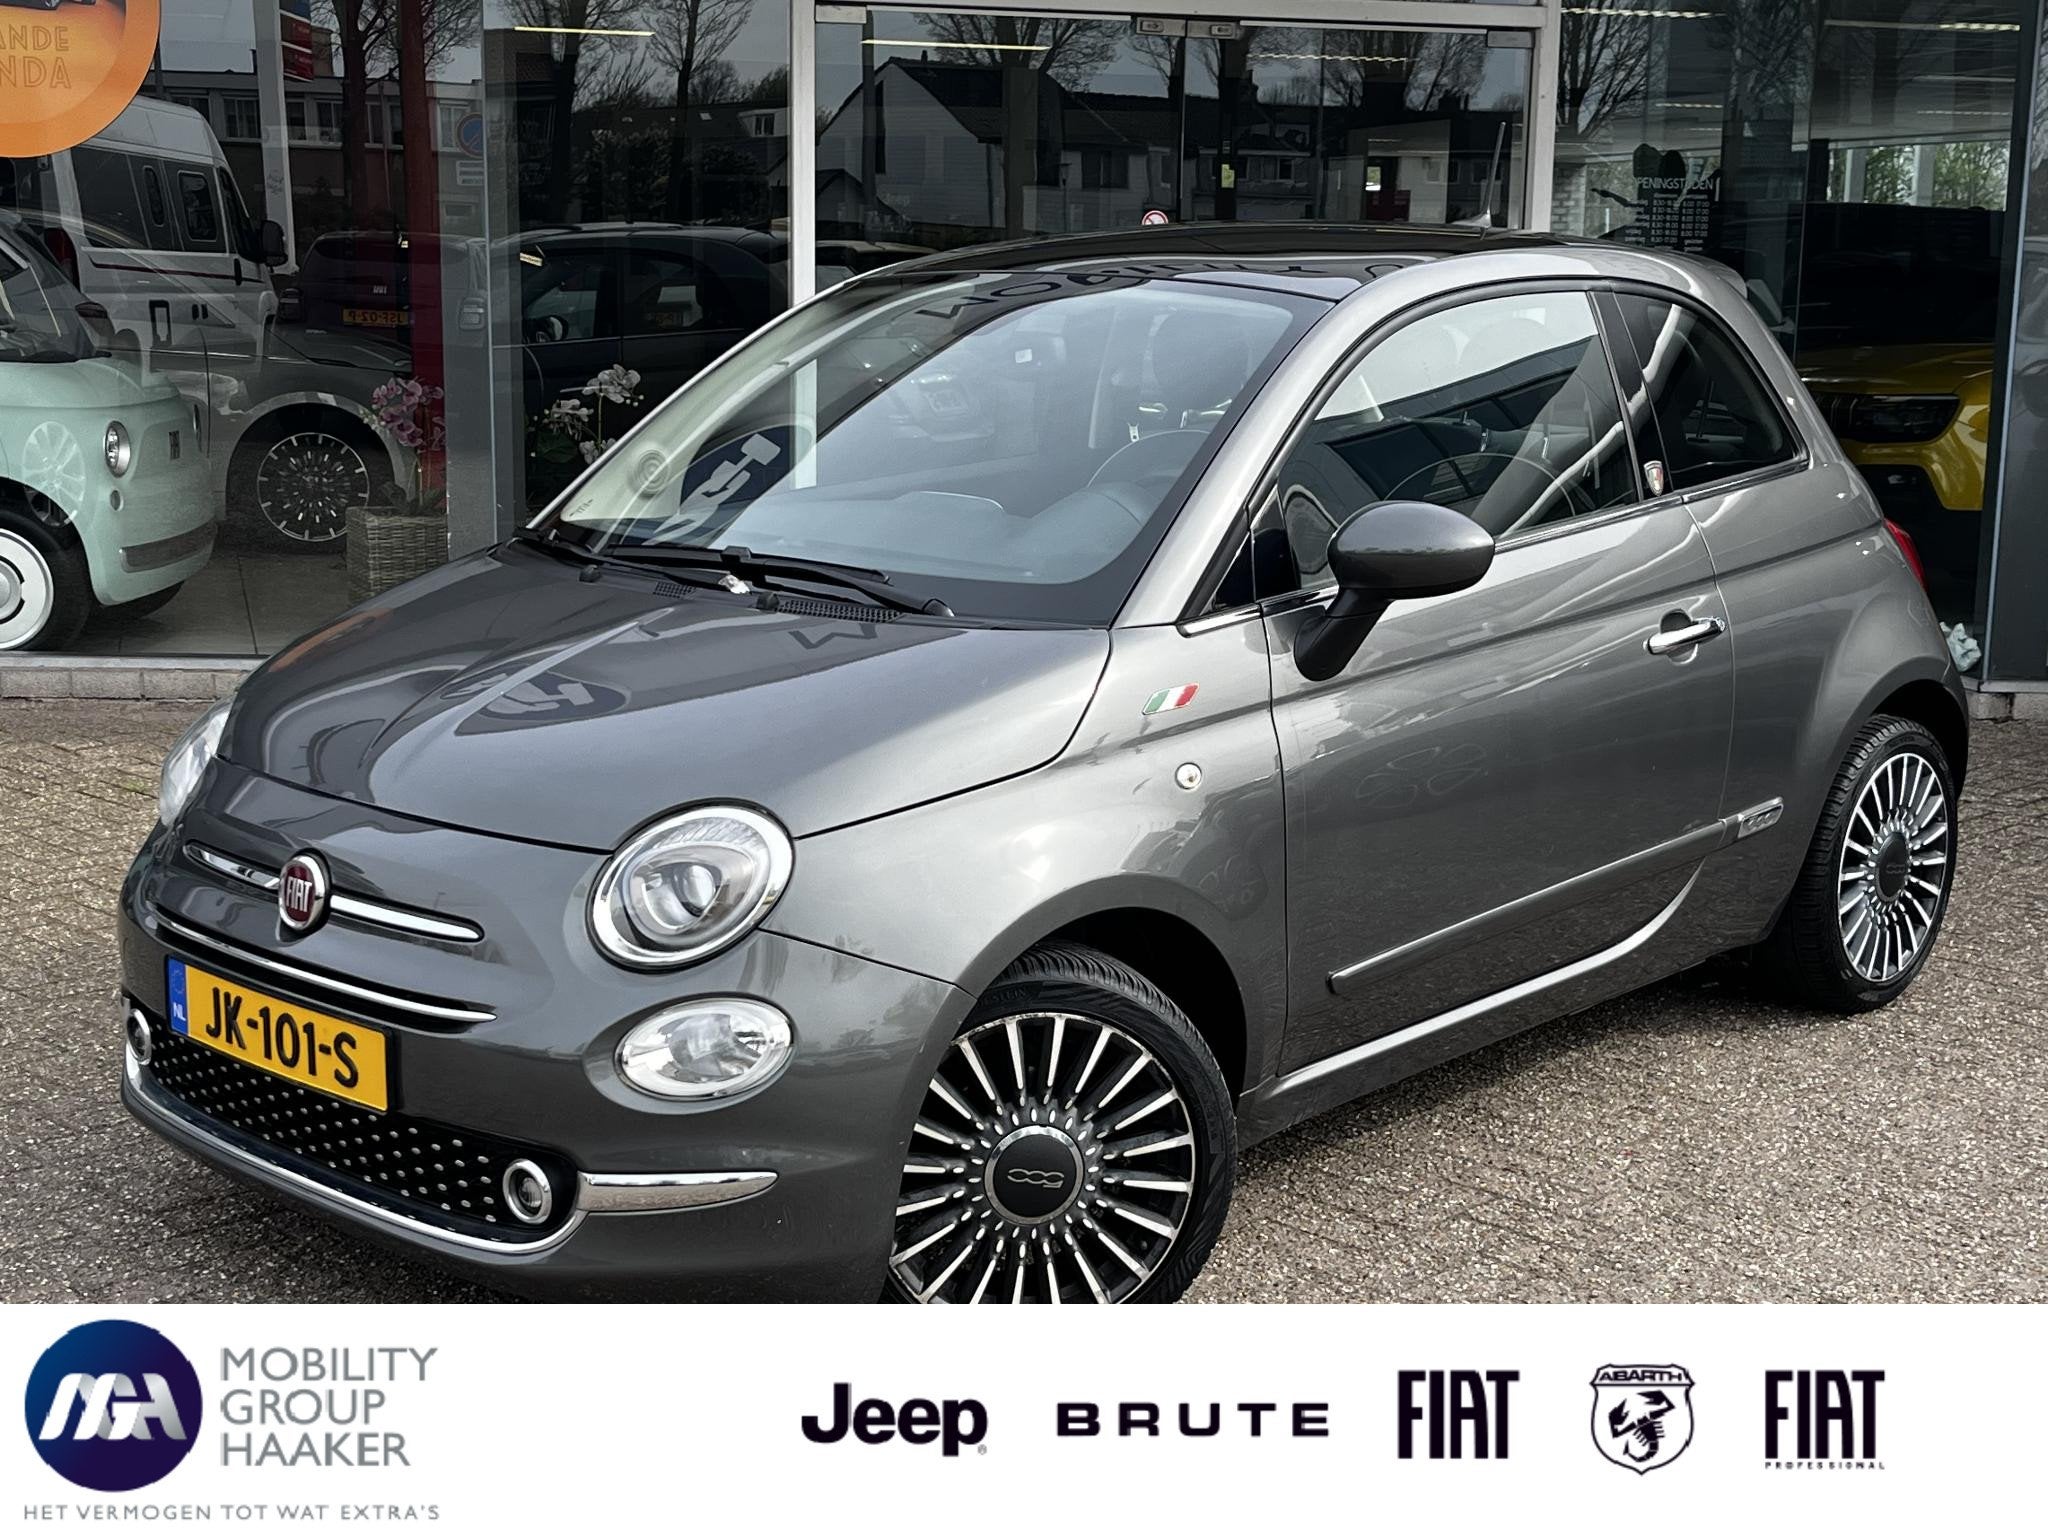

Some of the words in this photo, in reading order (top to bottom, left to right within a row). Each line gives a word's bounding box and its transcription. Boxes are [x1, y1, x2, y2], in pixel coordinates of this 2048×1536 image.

[286, 876, 313, 912] FIAT
[173, 1002, 187, 1021] NL
[205, 987, 359, 1088] JK-101-S
